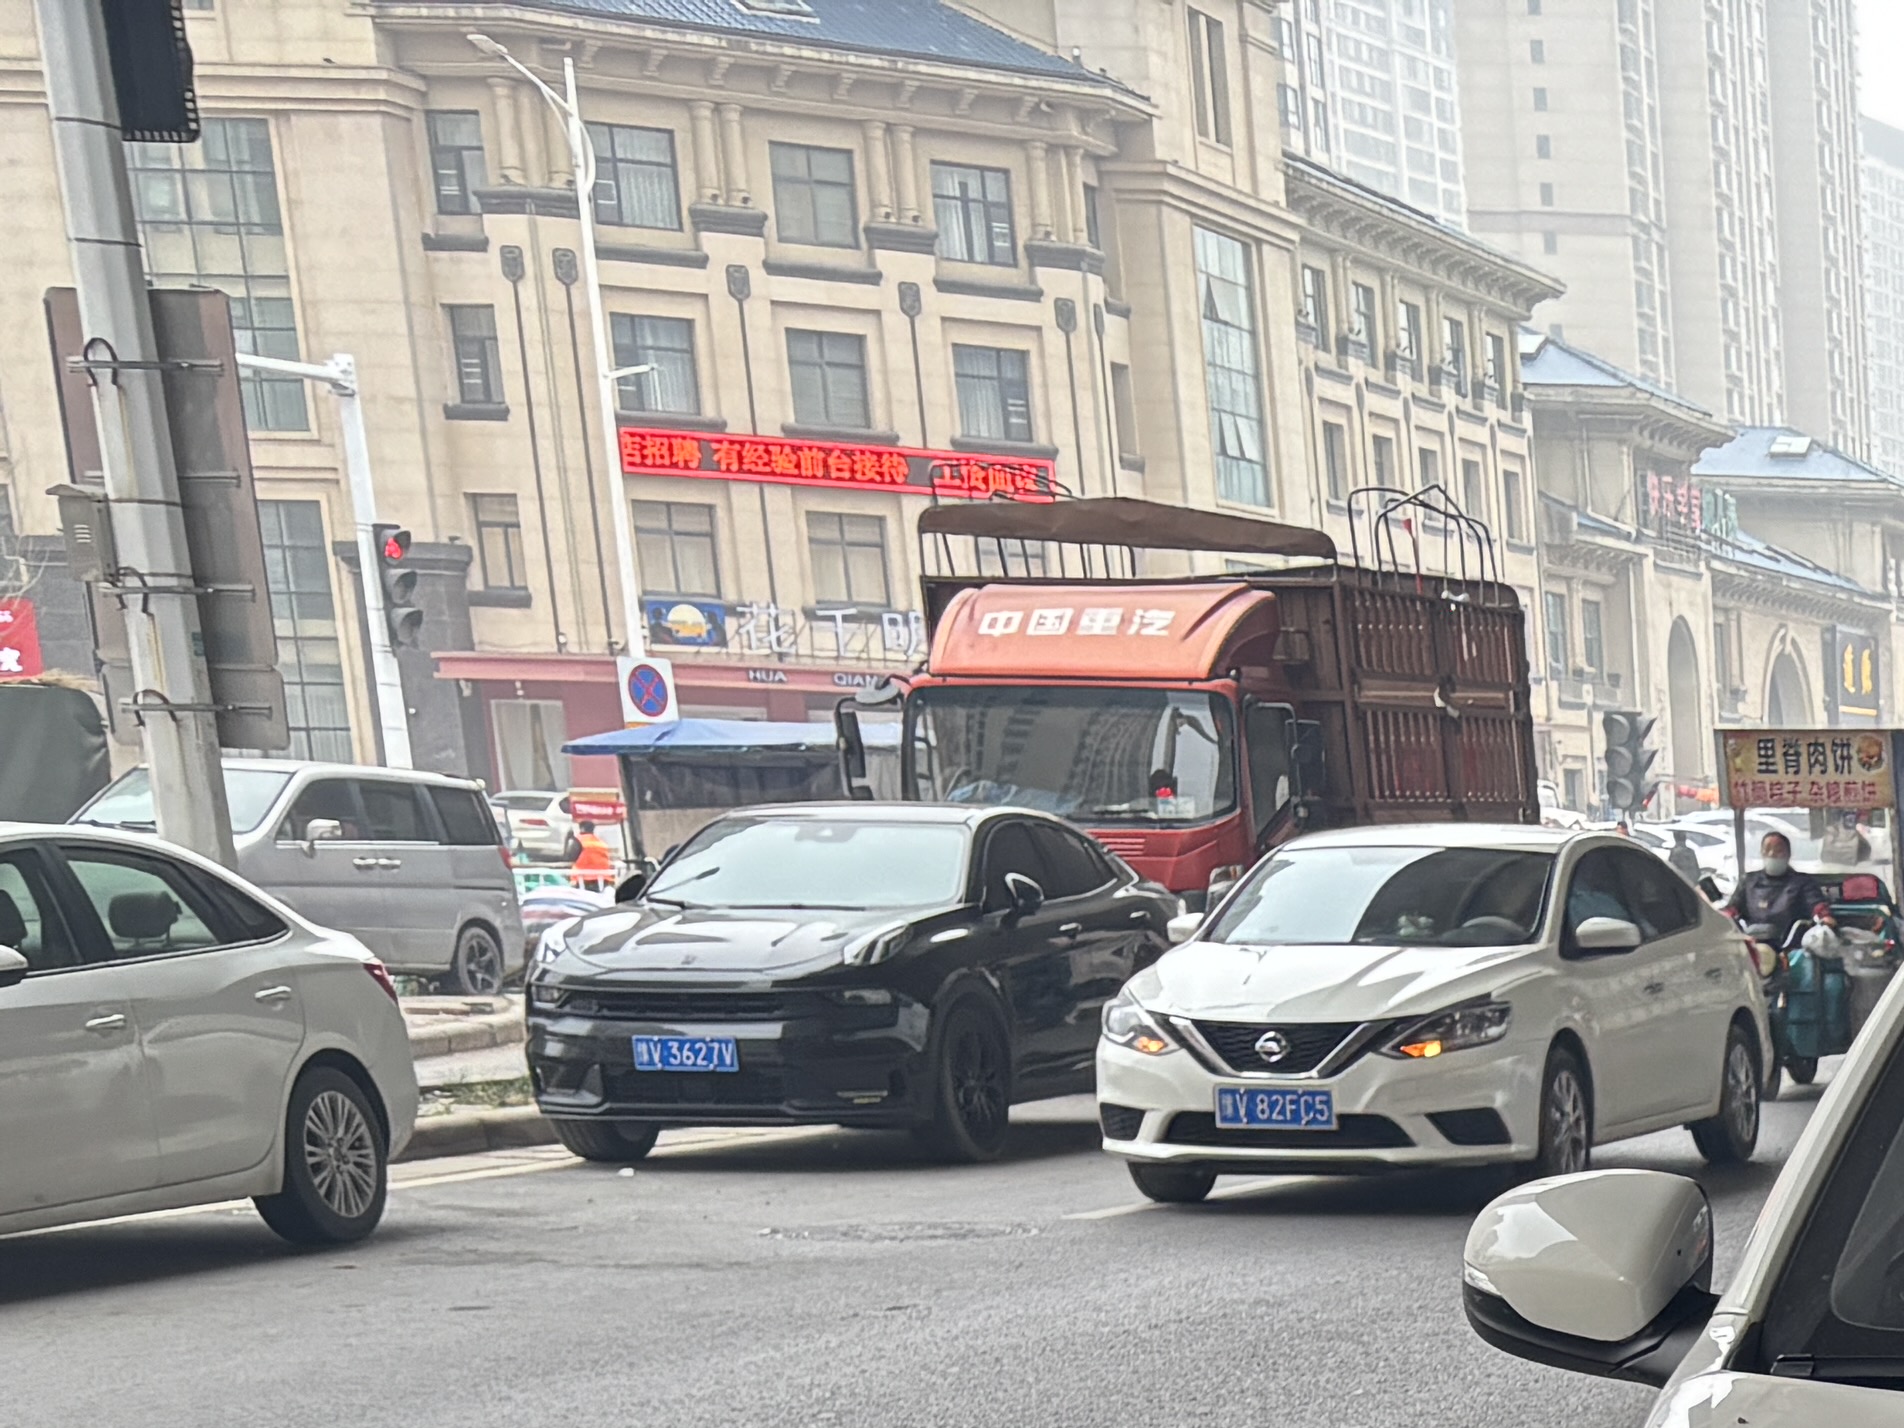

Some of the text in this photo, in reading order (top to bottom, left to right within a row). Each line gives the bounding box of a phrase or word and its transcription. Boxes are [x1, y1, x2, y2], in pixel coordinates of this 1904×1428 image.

[711, 440, 909, 484] 有经验前台接待
[977, 608, 1177, 637] 中国重汽
[749, 670, 788, 683] HUA
[1756, 737, 1853, 775] 里脊肉饼
